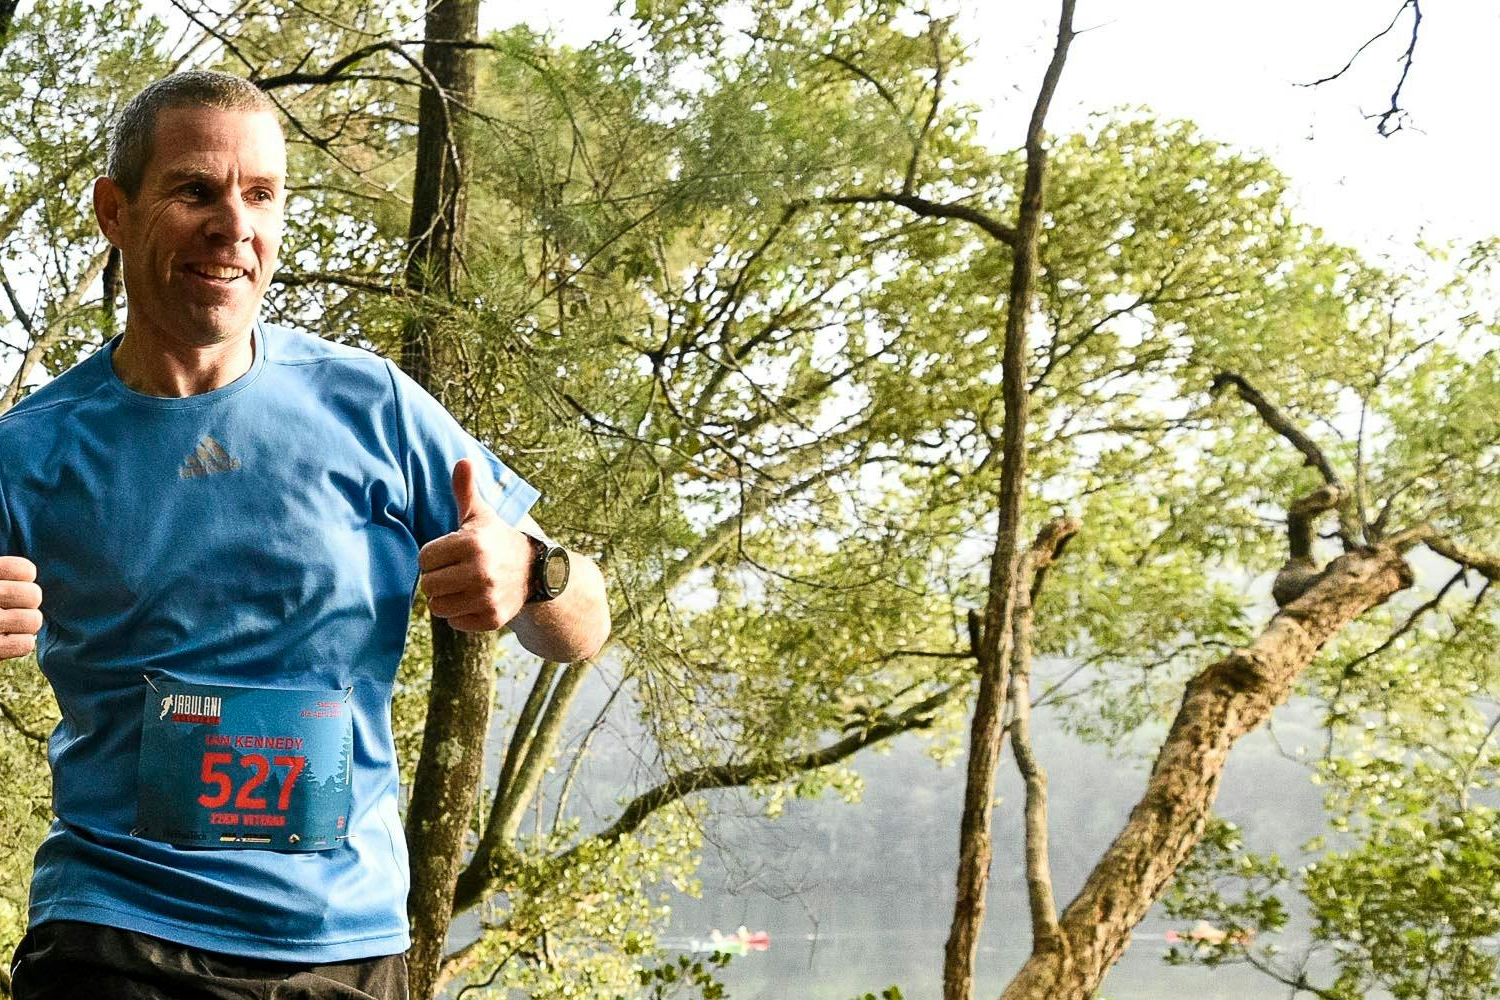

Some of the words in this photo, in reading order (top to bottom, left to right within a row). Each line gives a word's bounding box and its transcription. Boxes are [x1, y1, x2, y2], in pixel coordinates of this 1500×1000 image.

[172, 694, 222, 717] JABULANI
[235, 735, 304, 750] KENNEDY
[197, 752, 306, 811] 527
